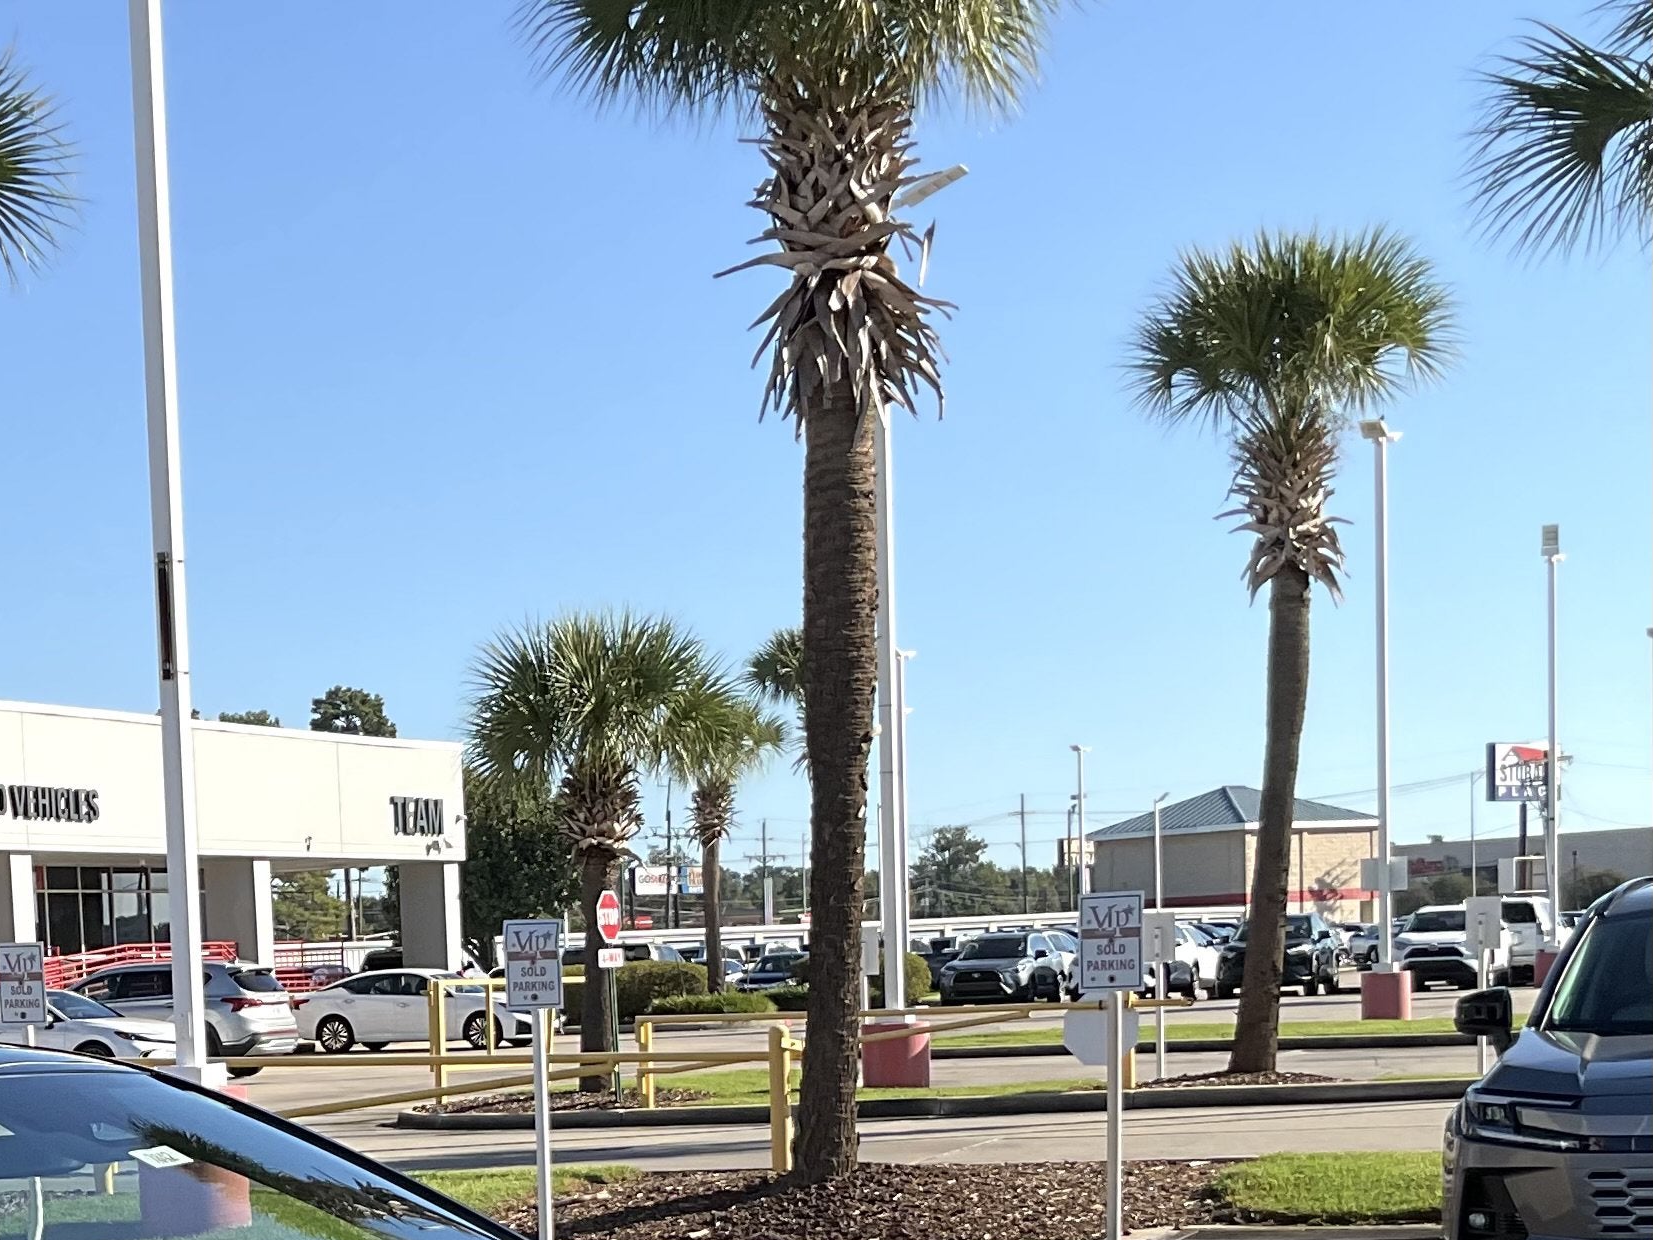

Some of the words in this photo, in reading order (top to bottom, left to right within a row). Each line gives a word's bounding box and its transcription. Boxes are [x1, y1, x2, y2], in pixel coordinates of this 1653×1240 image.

[1498, 786, 1547, 798] PLAC
[8, 785, 99, 823] VEHICLES
[389, 796, 444, 836] TEAM
[1096, 944, 1126, 955] SOLD
[1087, 959, 1135, 971] PARKING
[520, 967, 547, 977] SOLD
[10, 985, 33, 995] SOLD
[512, 981, 555, 992] PARKING
[4, 998, 40, 1008] PARKING
